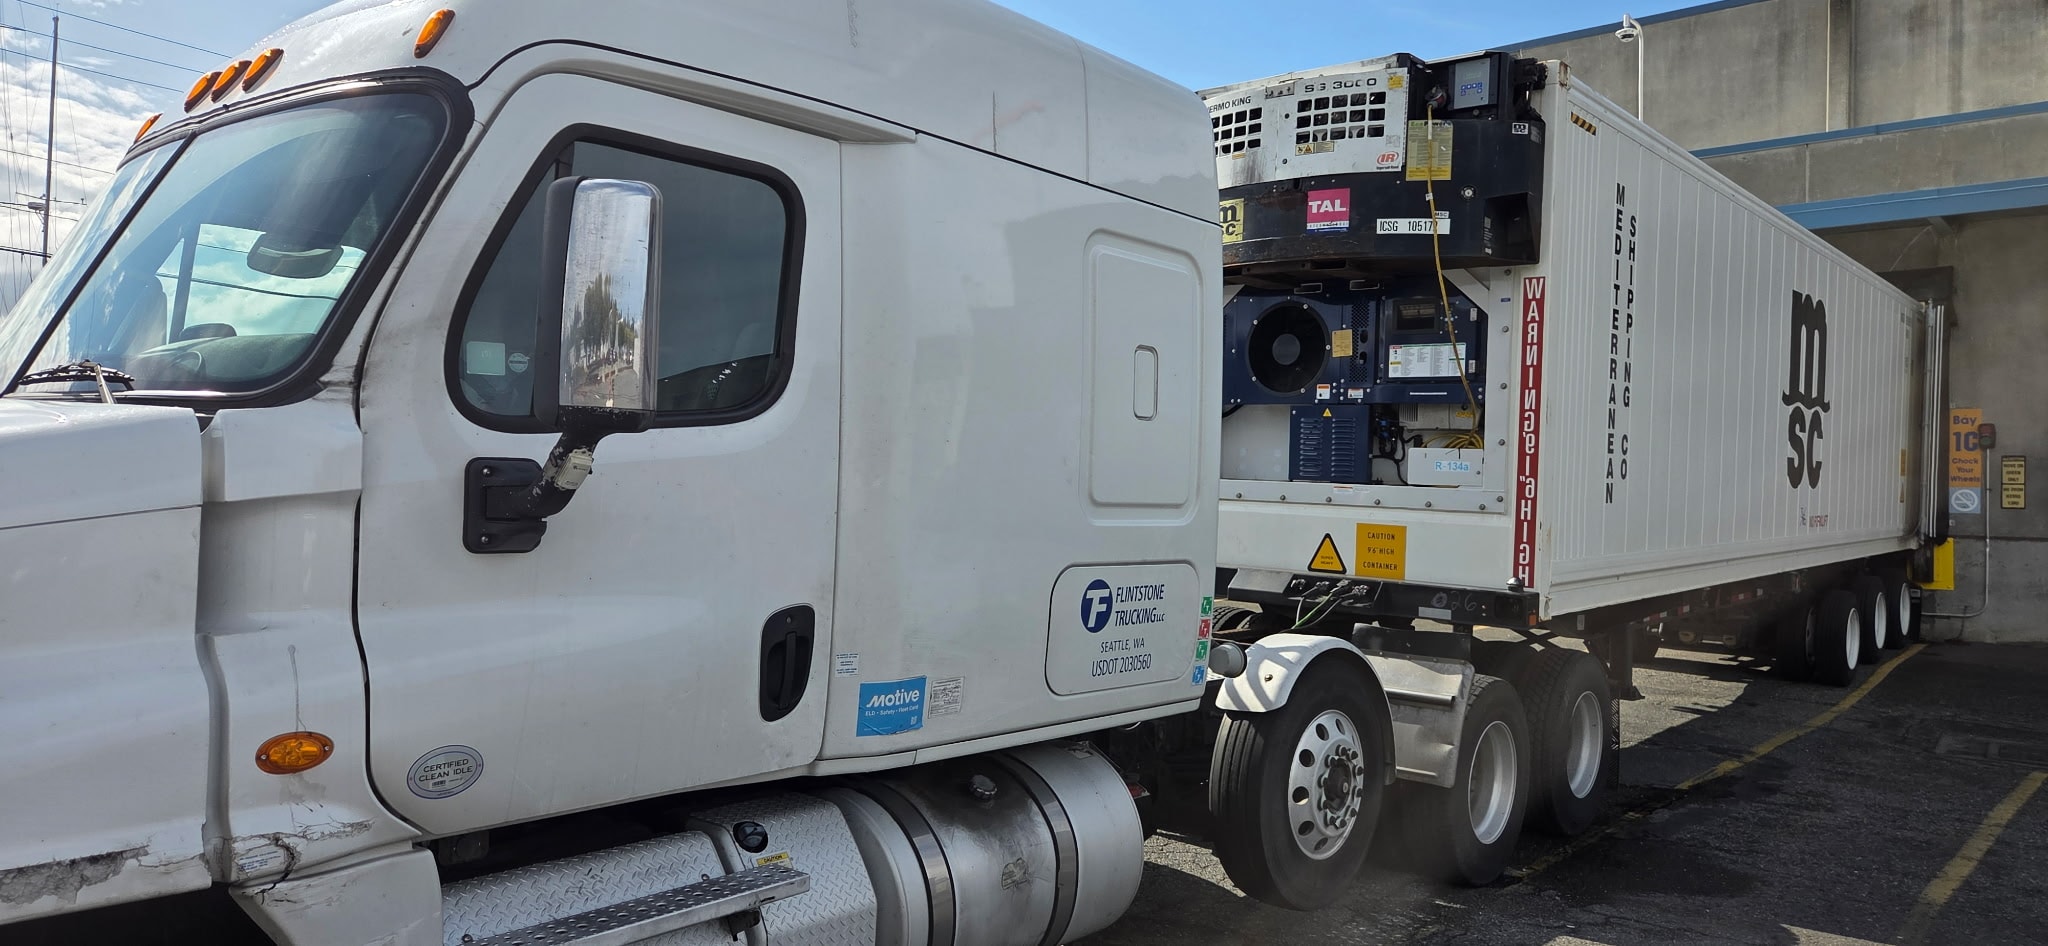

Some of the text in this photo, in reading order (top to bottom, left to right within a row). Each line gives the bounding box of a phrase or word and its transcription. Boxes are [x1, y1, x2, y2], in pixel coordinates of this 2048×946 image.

[1208, 95, 1252, 114] ERMO KING
[1309, 199, 1347, 214] TAL
[1379, 220, 1398, 232] ICSG
[1605, 182, 1625, 504] MEDITERRANEAN
[1620, 215, 1637, 480] SHIPPING CO
[1953, 415, 1977, 427] Bay
[1953, 431, 1979, 452] 1C
[1435, 461, 1469, 471] R-134a
[1952, 457, 1979, 465] Chock
[1956, 466, 1974, 474] Your
[1367, 532, 1396, 541] CAUTION
[1379, 547, 1395, 555] HIGH
[1362, 561, 1398, 571] CONTAINER
[1115, 583, 1165, 604] FLINTSTONE
[1114, 606, 1156, 627] TRUCKING
[1100, 638, 1146, 654] SEATTLE, WA
[1091, 653, 1152, 678] USDOT 2030560
[866, 688, 920, 708] Motive
[423, 758, 469, 773] CERTIFIED
[418, 770, 450, 783] CLEAN
[453, 765, 473, 776] IDLE
